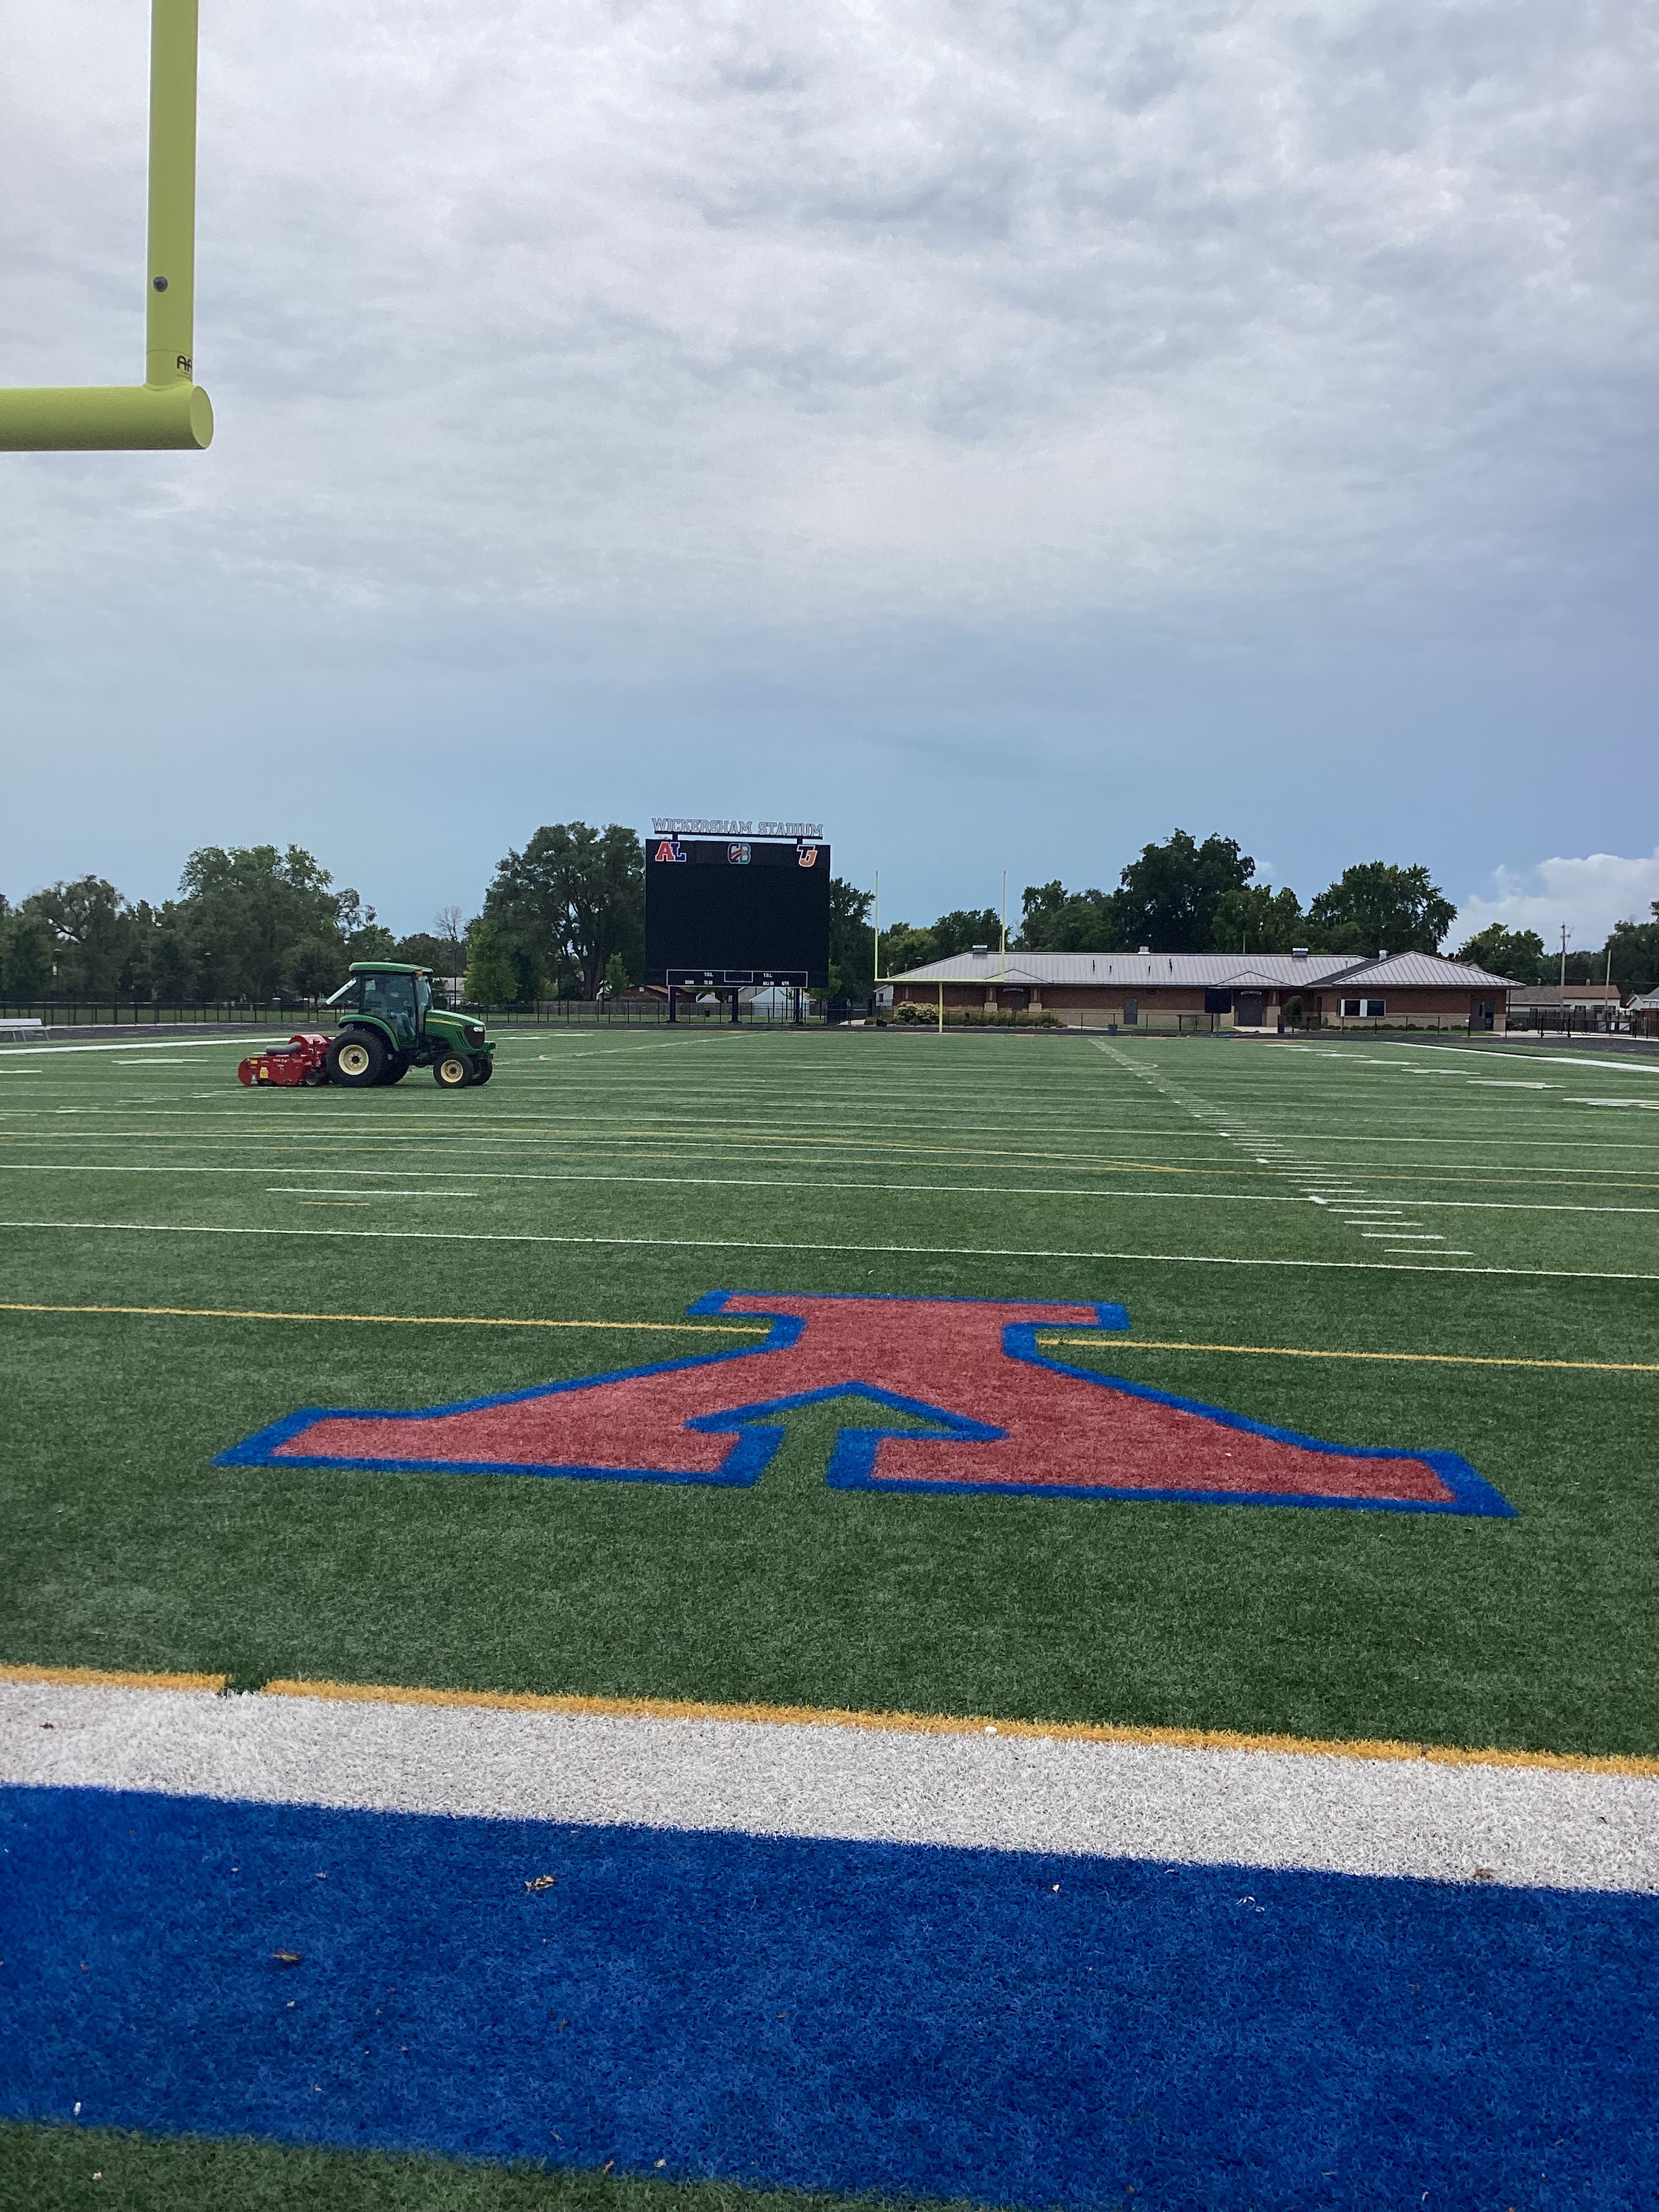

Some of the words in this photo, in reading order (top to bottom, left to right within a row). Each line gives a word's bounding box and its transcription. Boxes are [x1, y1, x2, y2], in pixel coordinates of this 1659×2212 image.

[652, 817, 752, 834] WICKERSHAM
[758, 821, 823, 837] STADIUM
[655, 841, 687, 862] AL
